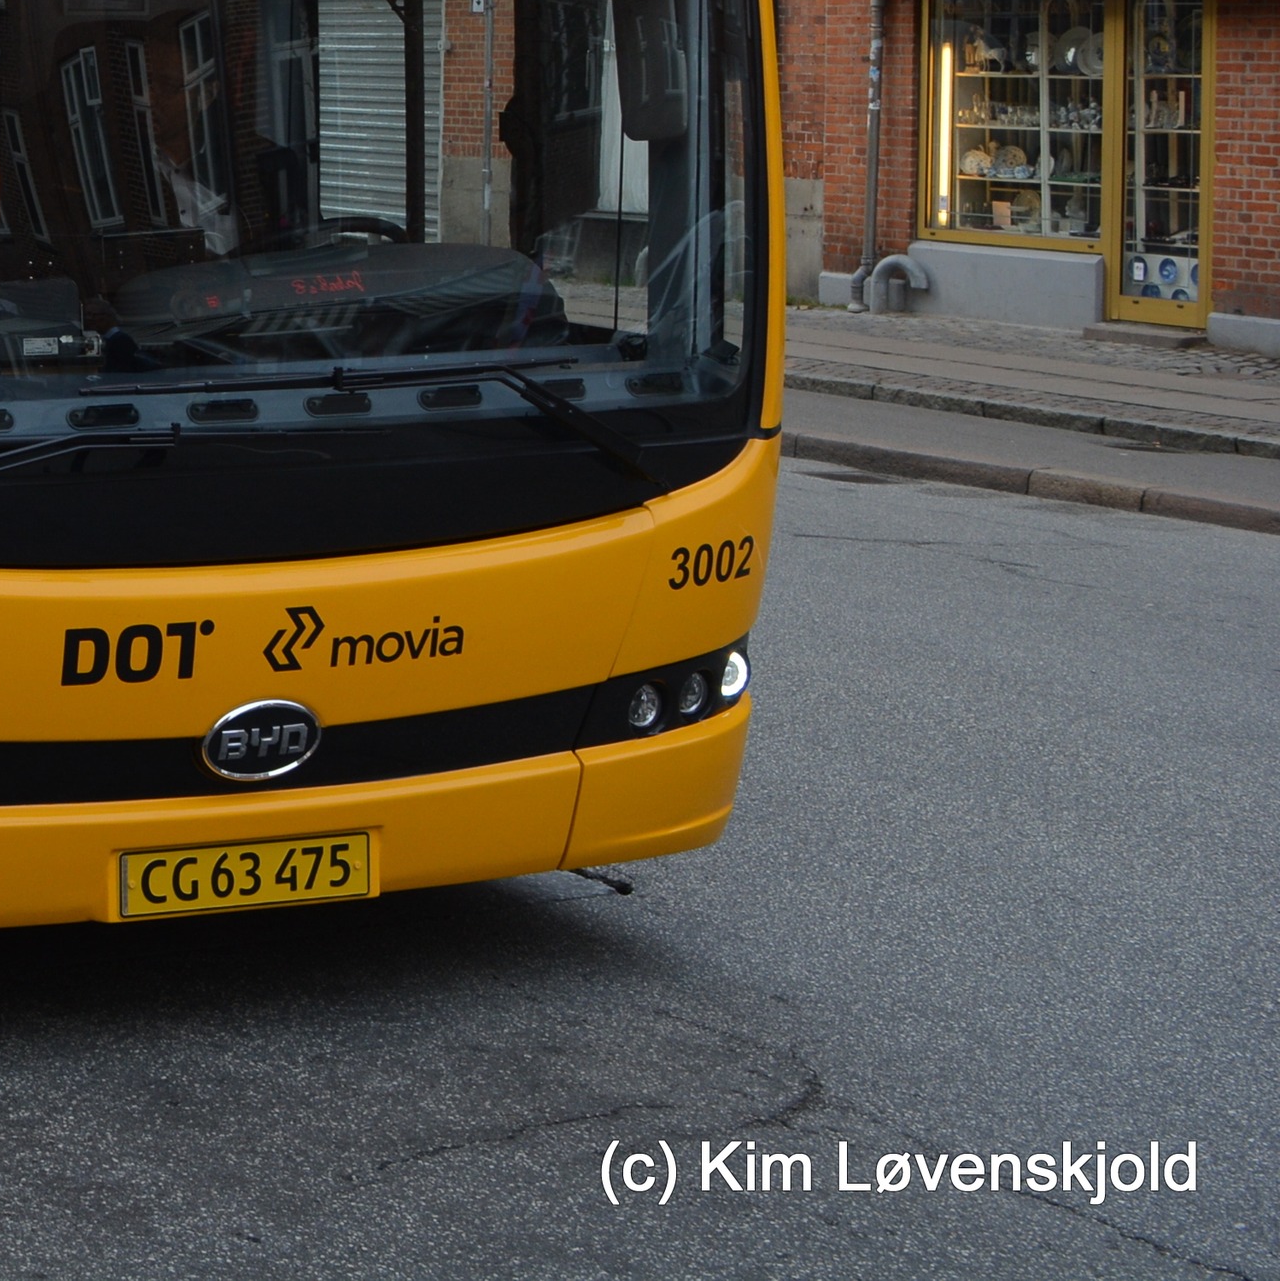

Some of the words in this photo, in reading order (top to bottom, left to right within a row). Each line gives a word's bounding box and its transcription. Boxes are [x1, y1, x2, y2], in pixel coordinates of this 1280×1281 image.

[669, 535, 754, 591] 3002
[61, 620, 215, 686] DOT
[330, 616, 465, 668] movia
[218, 724, 308, 760] BYD
[140, 857, 199, 904] CG
[212, 850, 262, 897] 63
[274, 843, 352, 892] 475
